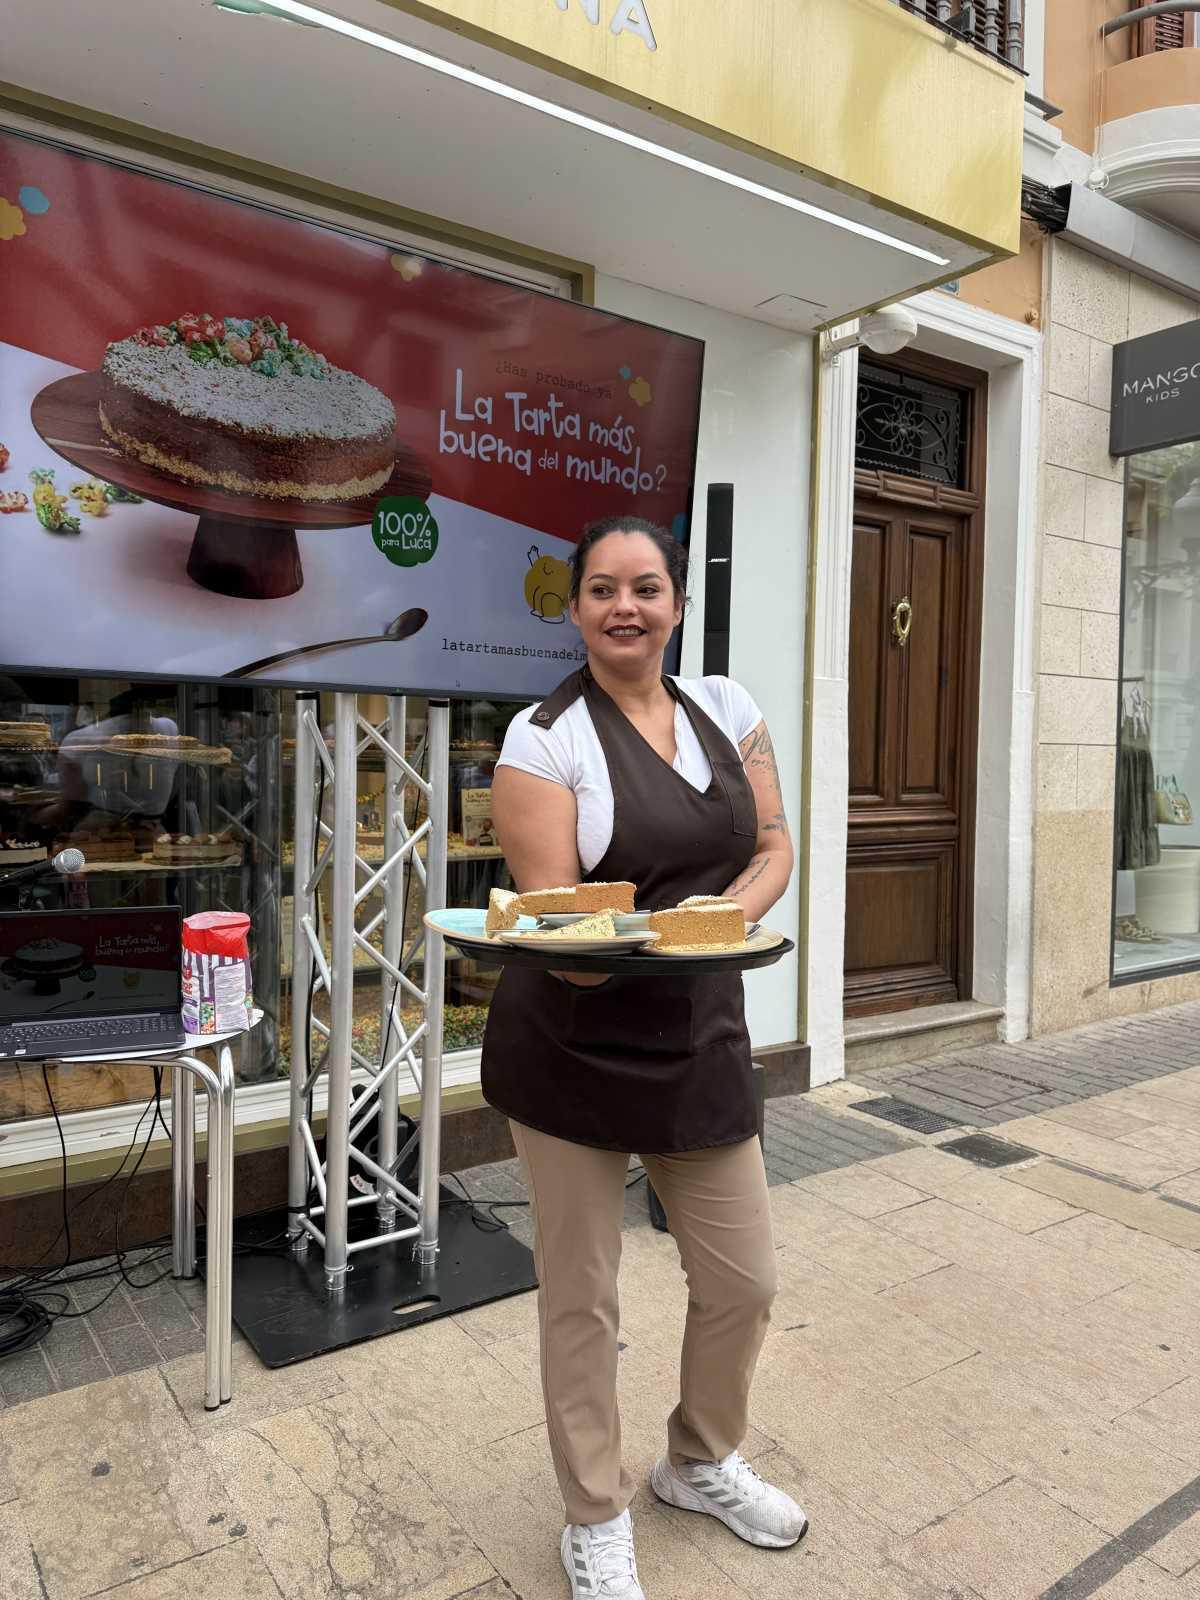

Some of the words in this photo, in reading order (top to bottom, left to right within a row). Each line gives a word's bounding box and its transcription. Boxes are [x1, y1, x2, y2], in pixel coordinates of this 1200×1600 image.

[1123, 361, 1200, 397] MANGO
[455, 367, 493, 425] La
[505, 392, 581, 440] Tarta
[589, 415, 635, 455] más
[1145, 387, 1180, 404] KIDS
[439, 409, 532, 476] buena
[538, 448, 559, 470] del
[566, 446, 667, 495] mundo?
[378, 511, 431, 537] 100%
[381, 539, 399, 549] para
[402, 533, 431, 550] Luca
